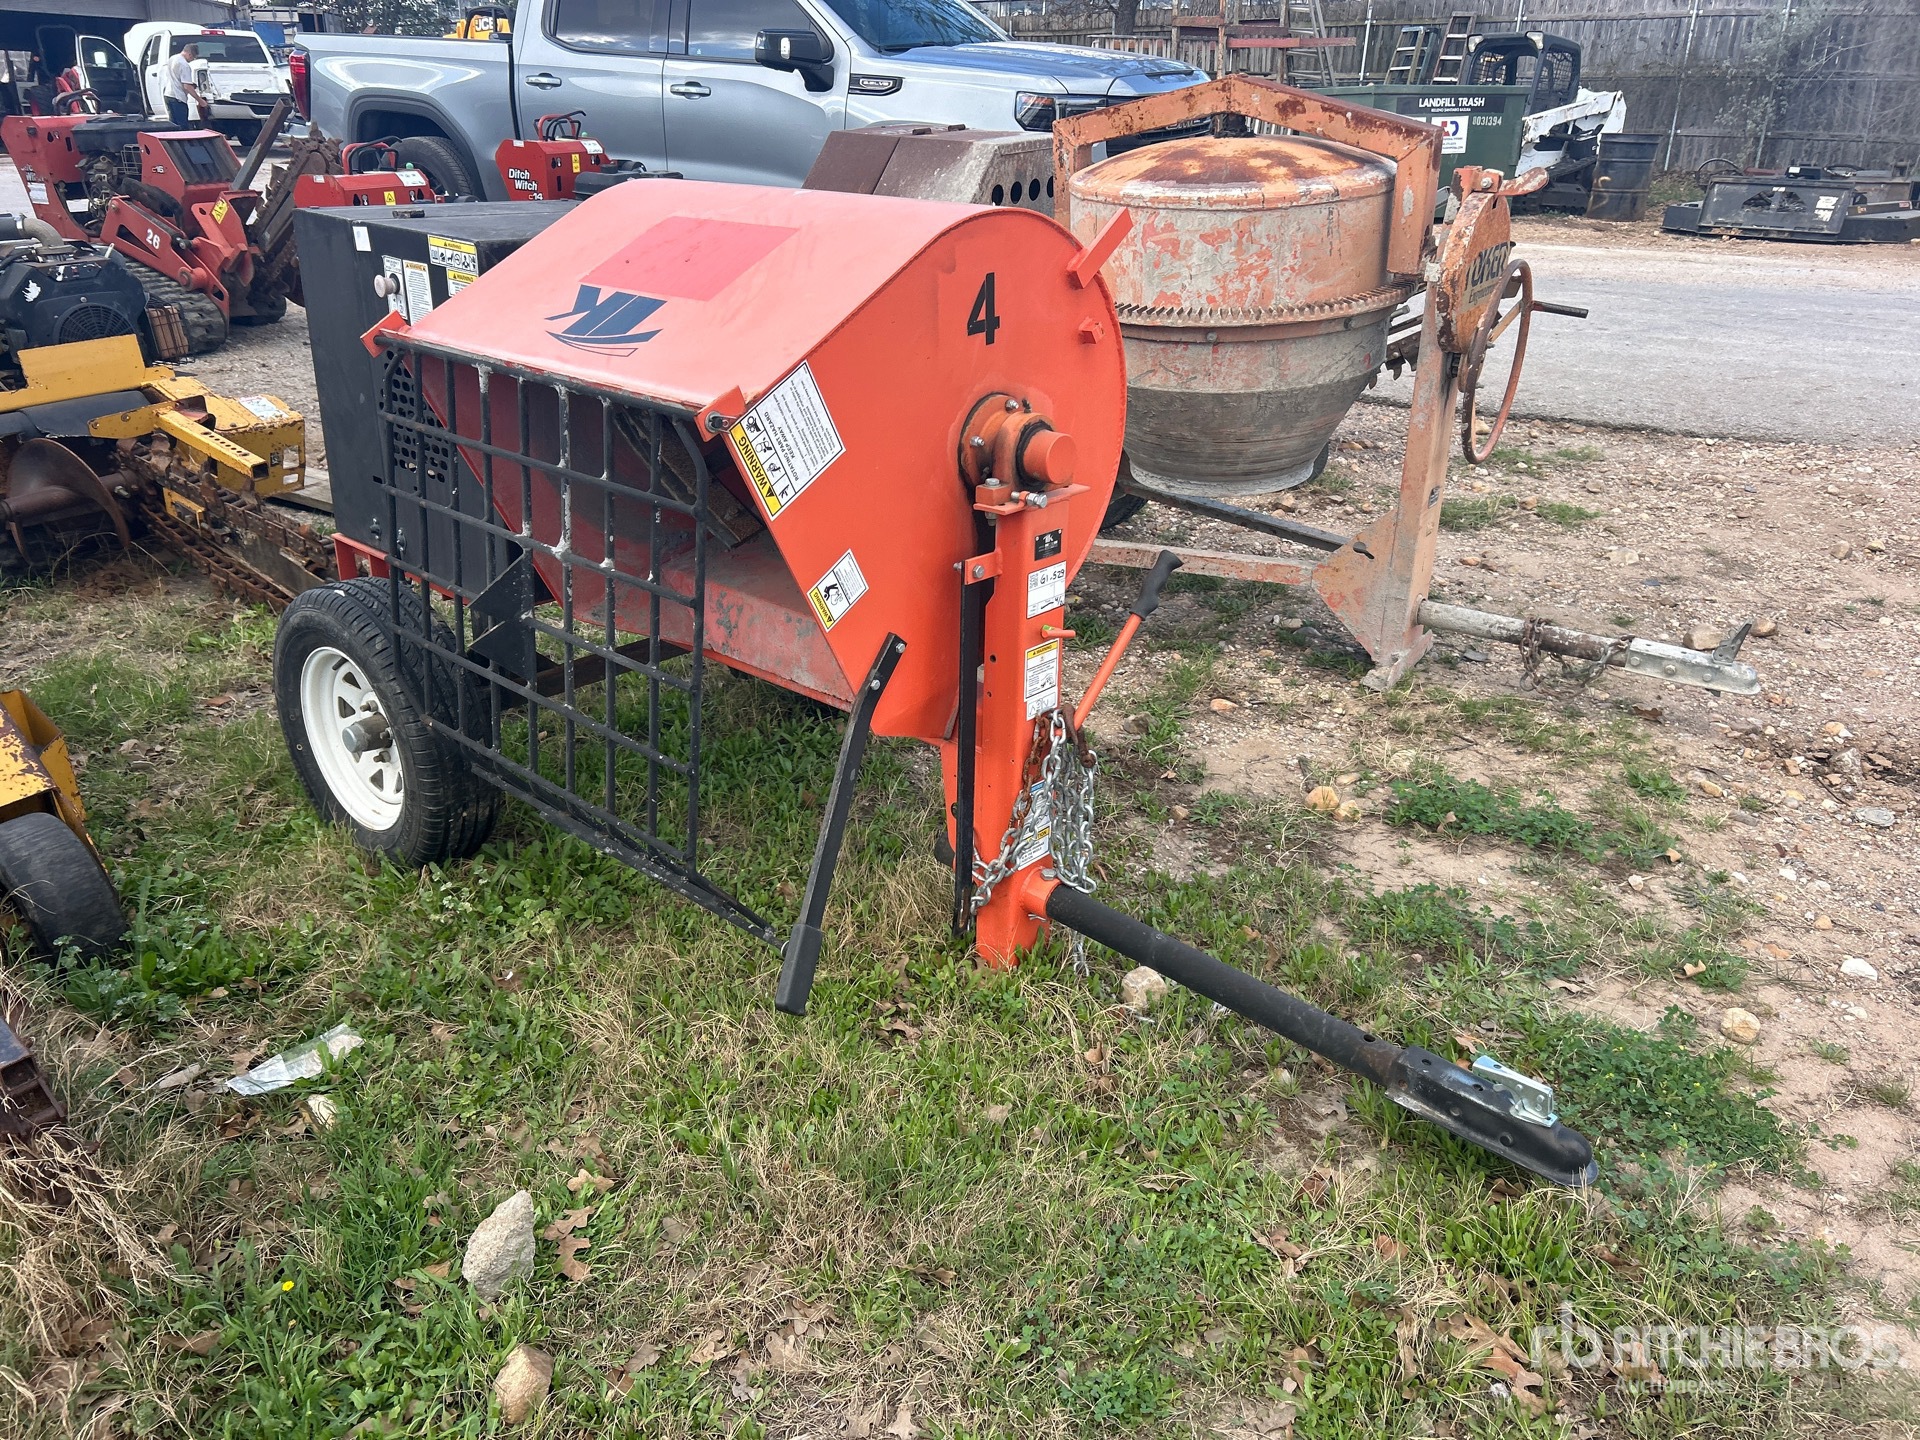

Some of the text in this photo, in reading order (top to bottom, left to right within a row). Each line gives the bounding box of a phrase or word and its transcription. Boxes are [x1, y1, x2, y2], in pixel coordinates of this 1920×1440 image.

[1419, 97, 1485, 108] LANDFILL TRASH
[508, 168, 530, 180] Ditch
[514, 180, 538, 191] Witch
[146, 229, 160, 249] 26
[967, 272, 1000, 345] 4
[763, 410, 779, 438] HAZARD
[775, 435, 786, 454] PART
[777, 424, 796, 460] KEEP AWAY
[738, 435, 767, 490] WARNING
[783, 451, 800, 482] ROTATING
